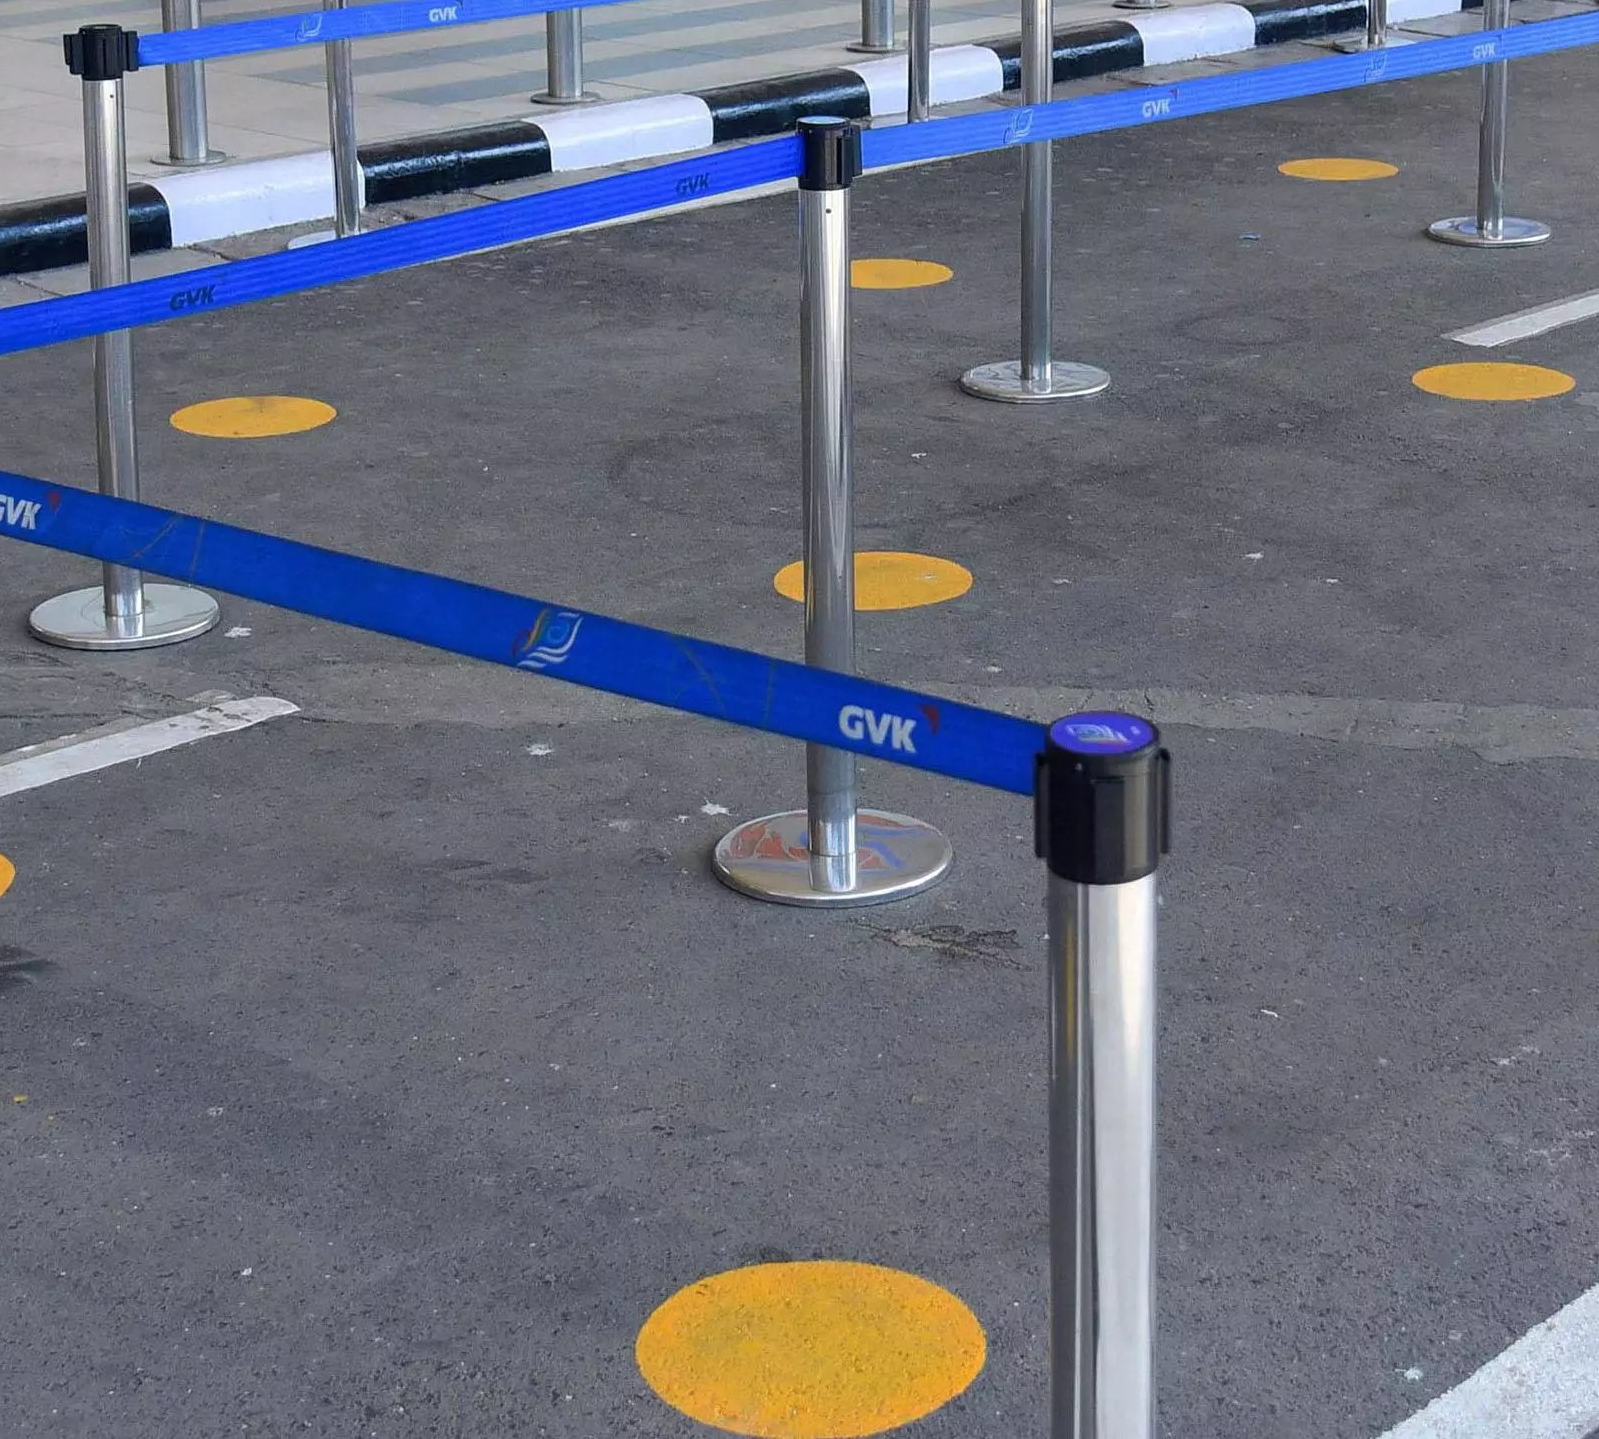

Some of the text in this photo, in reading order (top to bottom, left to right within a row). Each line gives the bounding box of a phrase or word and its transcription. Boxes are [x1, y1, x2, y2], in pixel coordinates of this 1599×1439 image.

[429, 7, 458, 23] GVK
[1142, 99, 1172, 119] GVK
[169, 282, 217, 313] GVK
[838, 704, 917, 754] GVK
